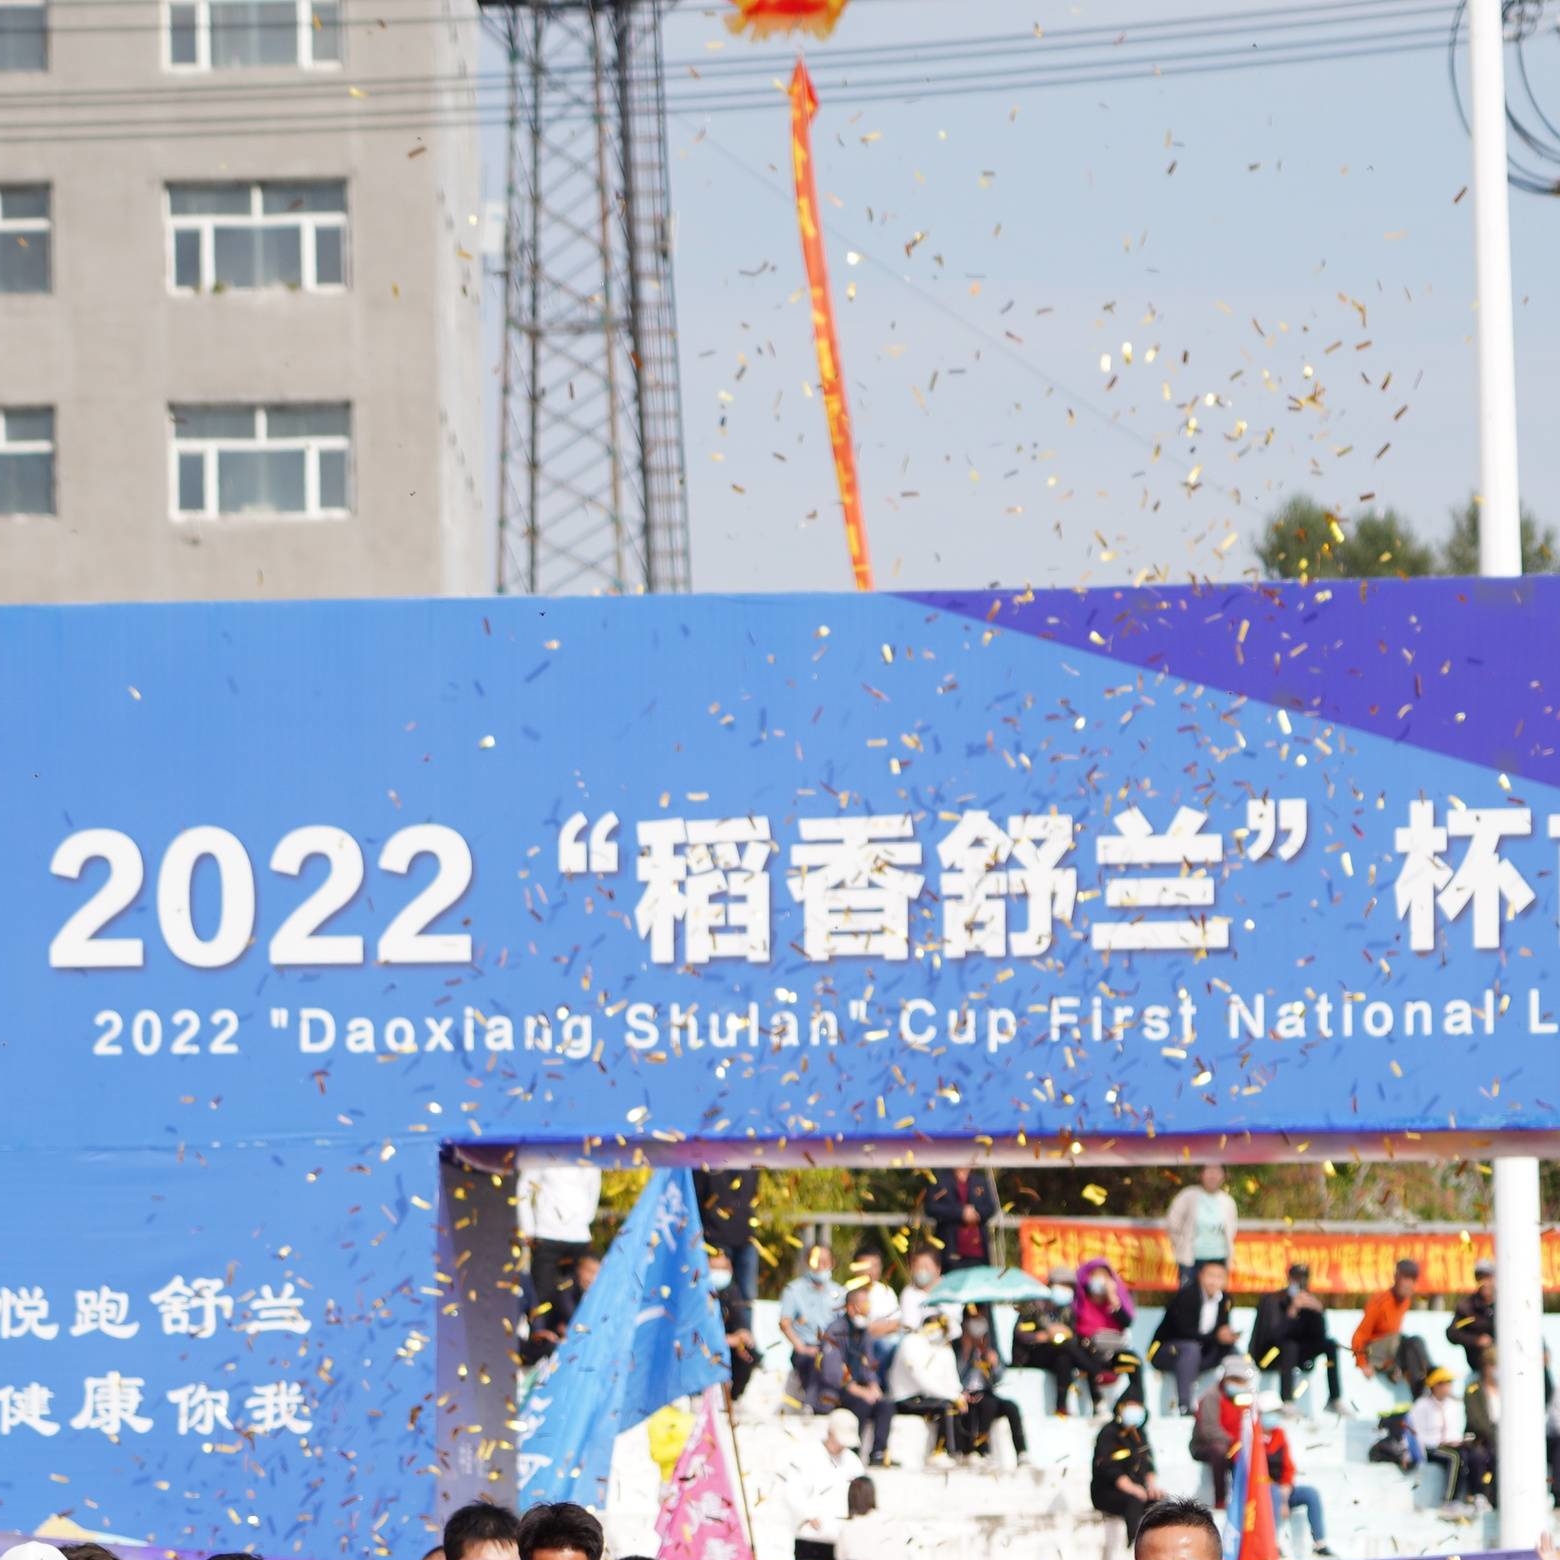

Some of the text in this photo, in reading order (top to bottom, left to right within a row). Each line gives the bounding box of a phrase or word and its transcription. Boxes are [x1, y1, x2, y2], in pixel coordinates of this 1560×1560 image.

[48, 825, 474, 968] 2022
[92, 1009, 240, 1055] 2022
[898, 998, 1017, 1053] Cup
[1049, 994, 1198, 1043] First
[1227, 989, 1497, 1039] National
